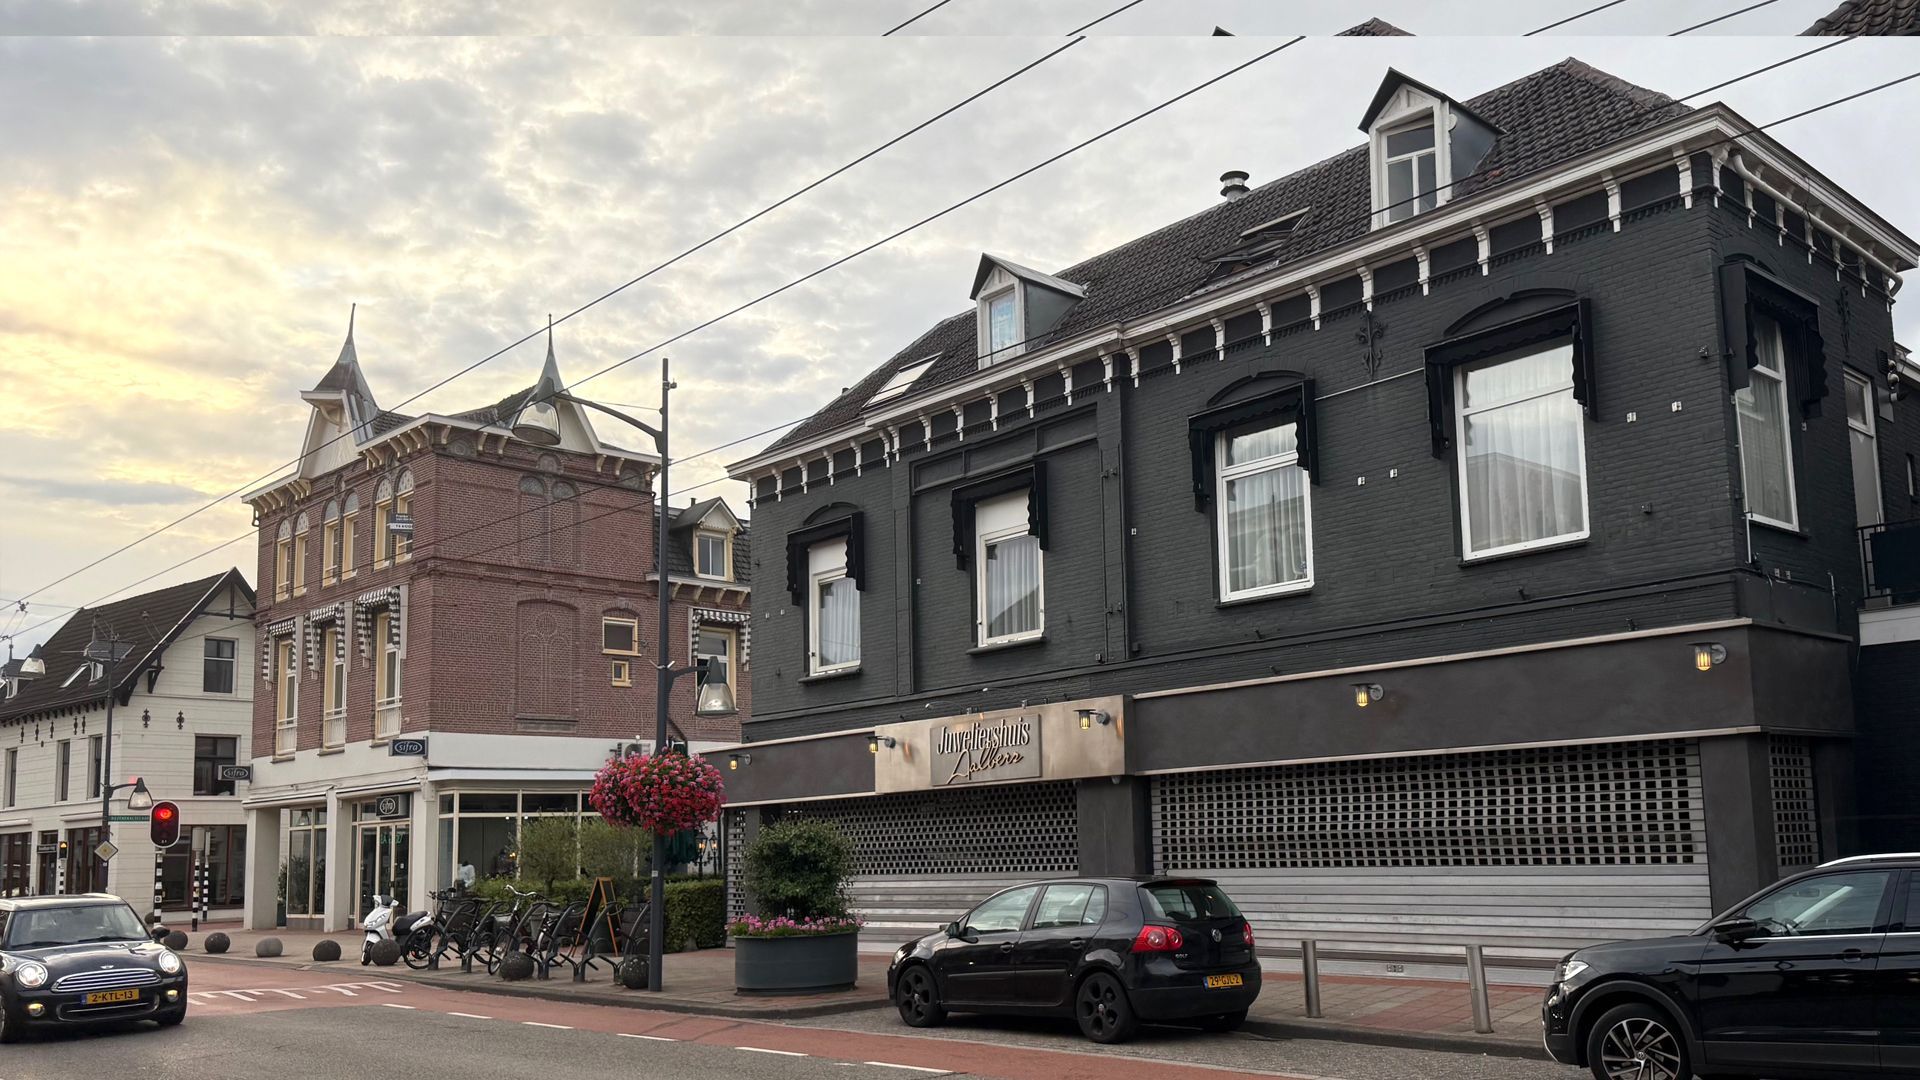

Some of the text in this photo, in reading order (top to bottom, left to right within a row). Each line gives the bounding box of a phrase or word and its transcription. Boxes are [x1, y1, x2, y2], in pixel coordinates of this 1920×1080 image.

[937, 717, 1030, 755] Juweliershuis
[398, 741, 418, 753] sifra
[91, 990, 133, 1003] 2-KTL-13
